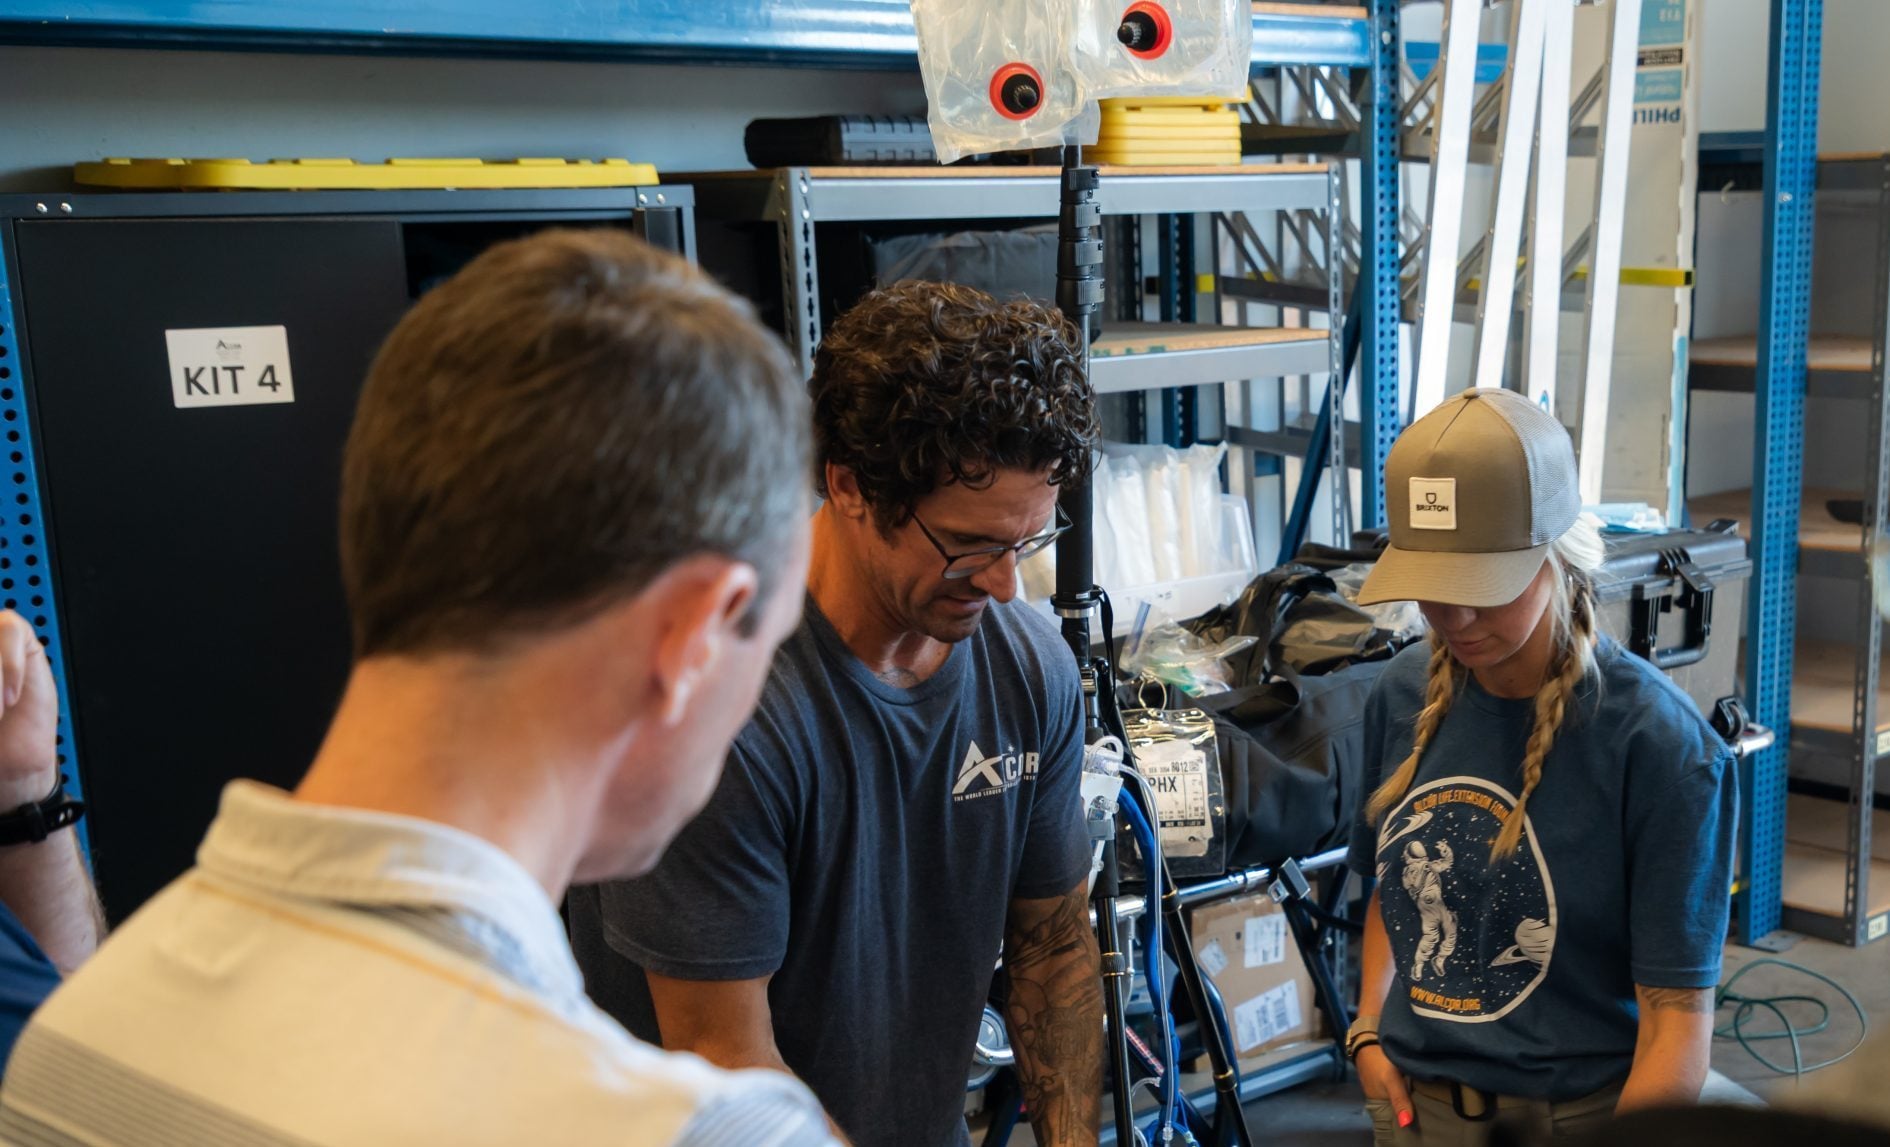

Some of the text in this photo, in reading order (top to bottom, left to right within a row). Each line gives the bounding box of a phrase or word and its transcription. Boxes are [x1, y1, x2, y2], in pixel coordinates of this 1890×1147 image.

[183, 364, 282, 396] KIT 4
[1416, 504, 1449, 512] BRIXTON
[1438, 790, 1454, 804] LIFE
[1454, 789, 1494, 810] EXTENSION
[1410, 985, 1481, 1011] WWW.ALCOR.ORG
